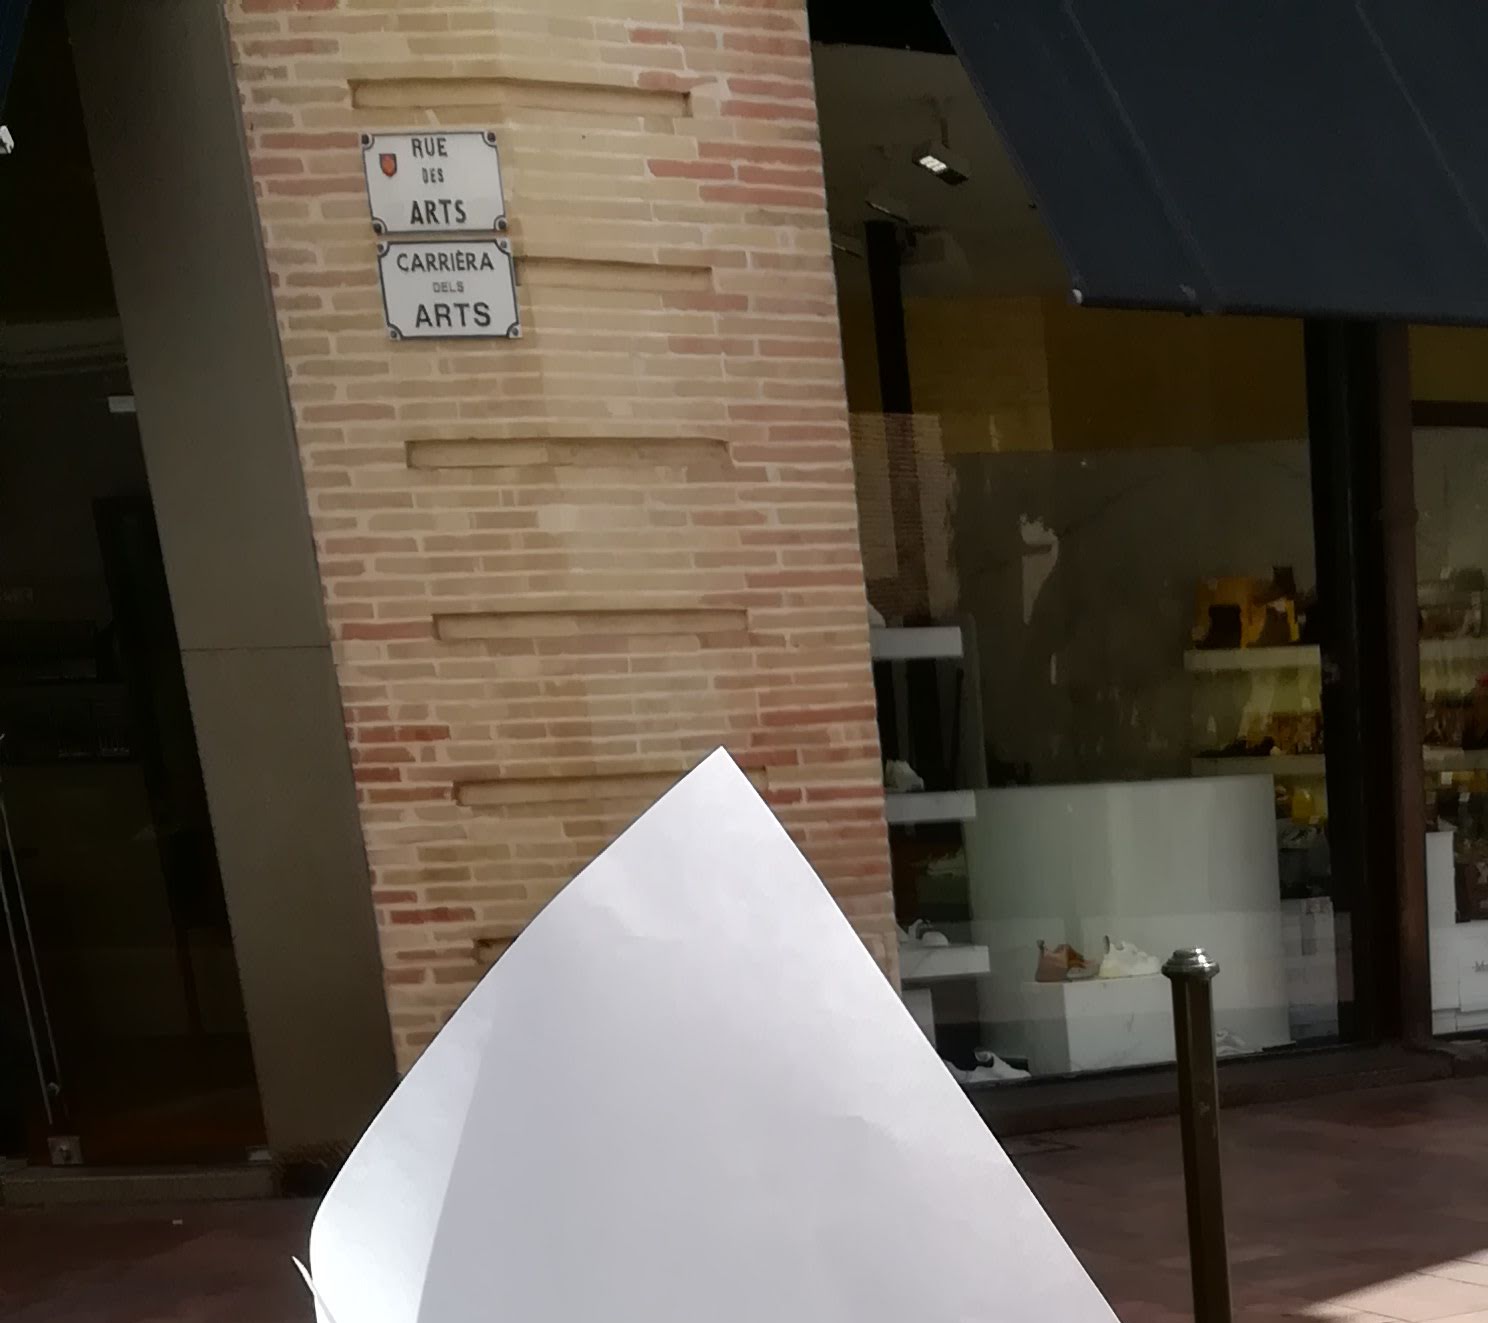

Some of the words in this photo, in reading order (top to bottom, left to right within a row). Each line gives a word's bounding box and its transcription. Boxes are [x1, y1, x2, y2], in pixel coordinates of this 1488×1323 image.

[411, 137, 448, 158] RUE
[422, 168, 445, 184] DES
[410, 199, 467, 225] ARTS
[432, 281, 465, 294] DELS
[415, 301, 492, 328] ARTS
